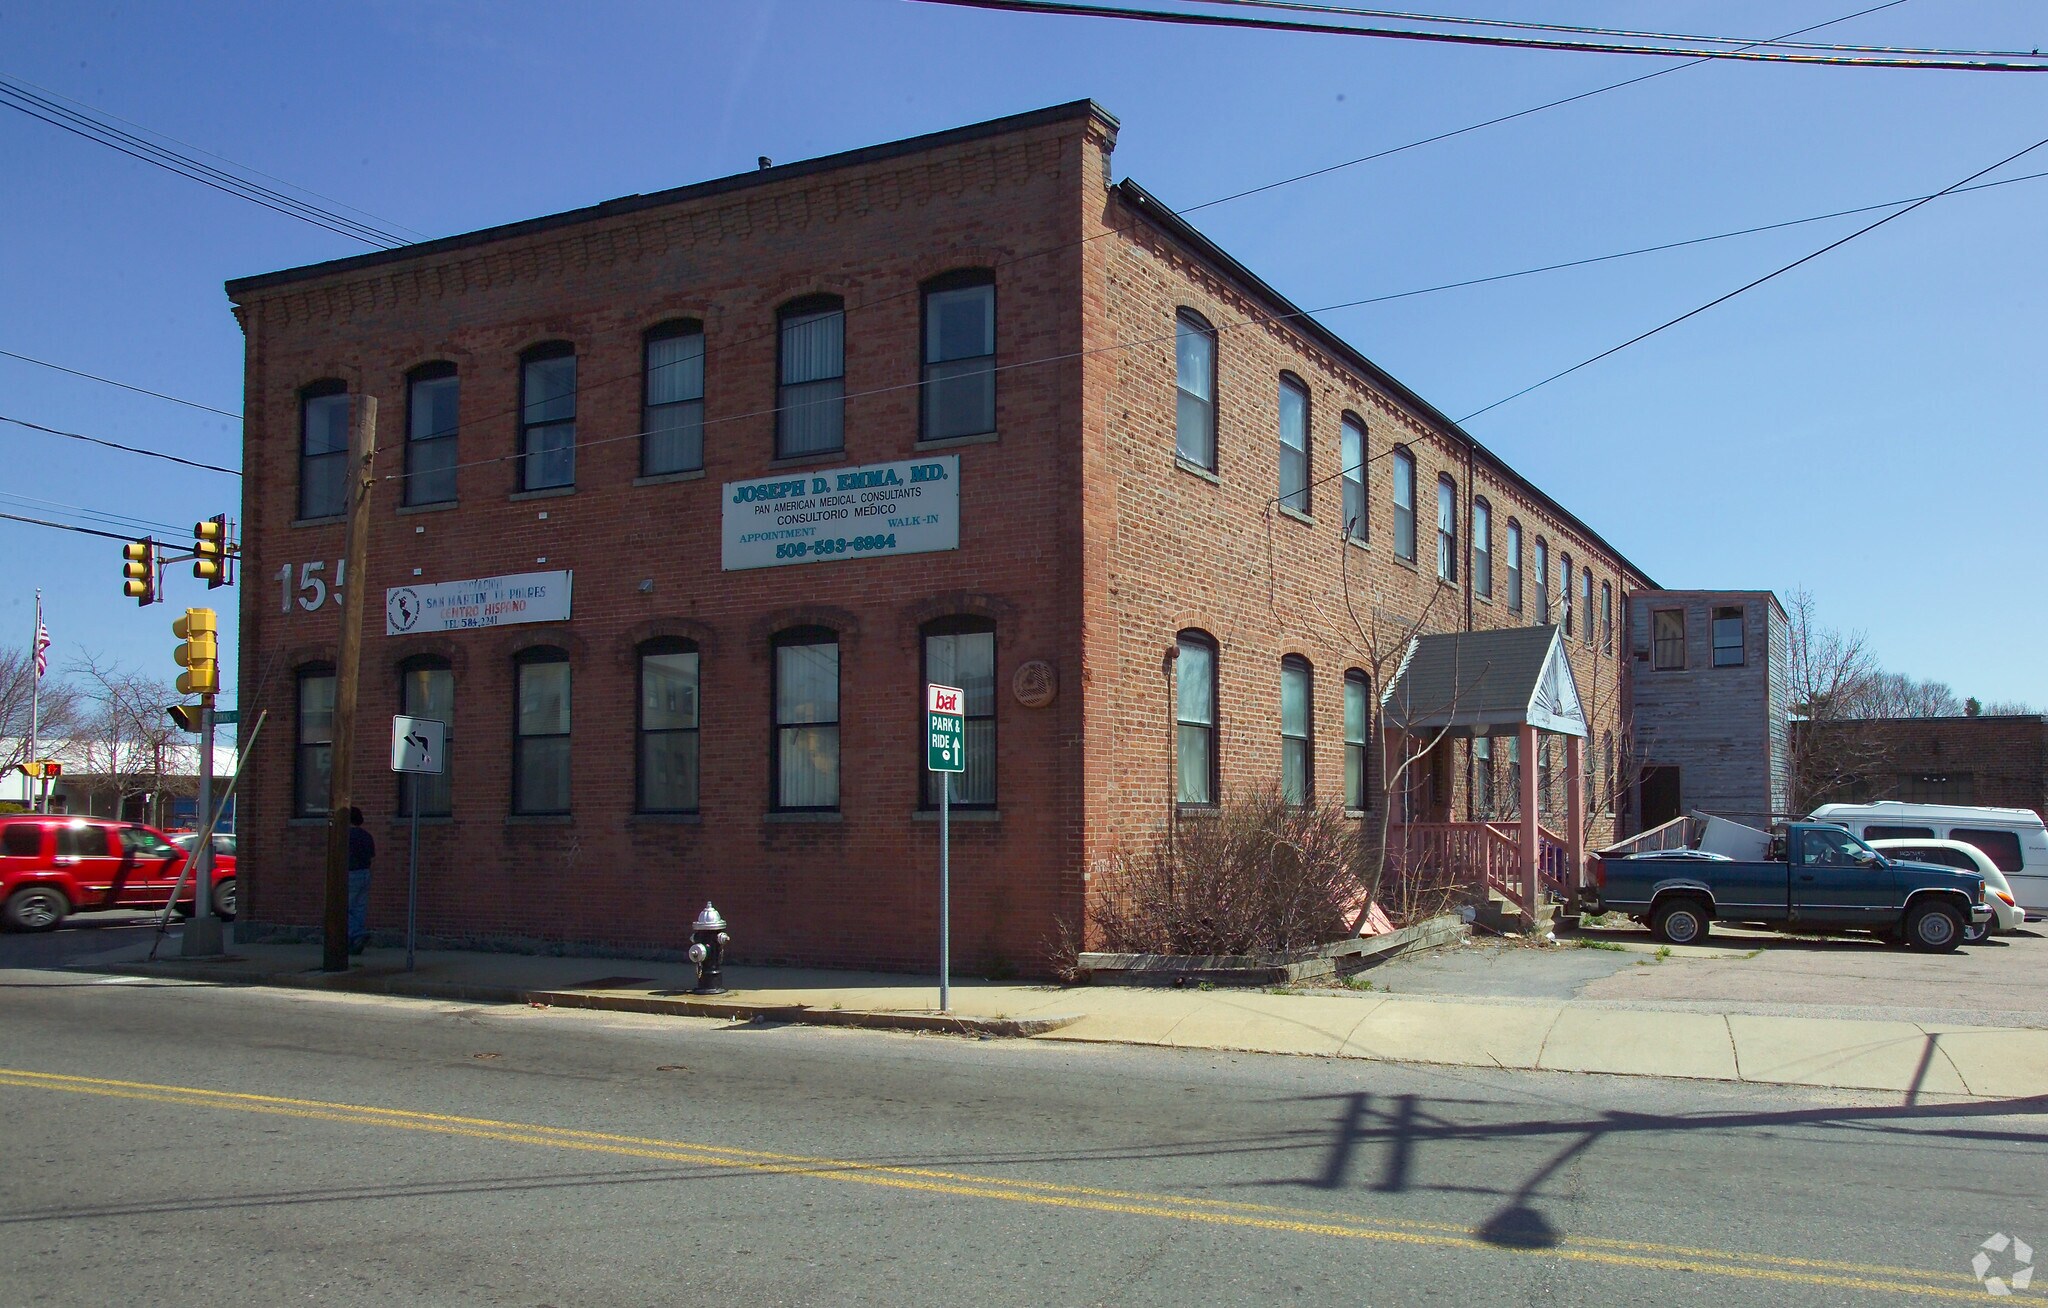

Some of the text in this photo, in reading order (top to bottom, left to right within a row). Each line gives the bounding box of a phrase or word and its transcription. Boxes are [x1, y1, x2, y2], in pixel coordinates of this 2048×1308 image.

[733, 463, 949, 504] JOSEPH D. EMMA, MD.
[754, 486, 922, 515] PAN AMERICAN MEDICAL CONSULTANTS
[777, 508, 849, 526] CONSULTORIO
[739, 527, 817, 544] APPOINTMENT
[426, 597, 445, 609] SAN
[440, 599, 527, 619] CENTRO HISPANO
[936, 691, 957, 710] bat
[932, 715, 960, 733] PARK &
[932, 733, 950, 749] RIDE
